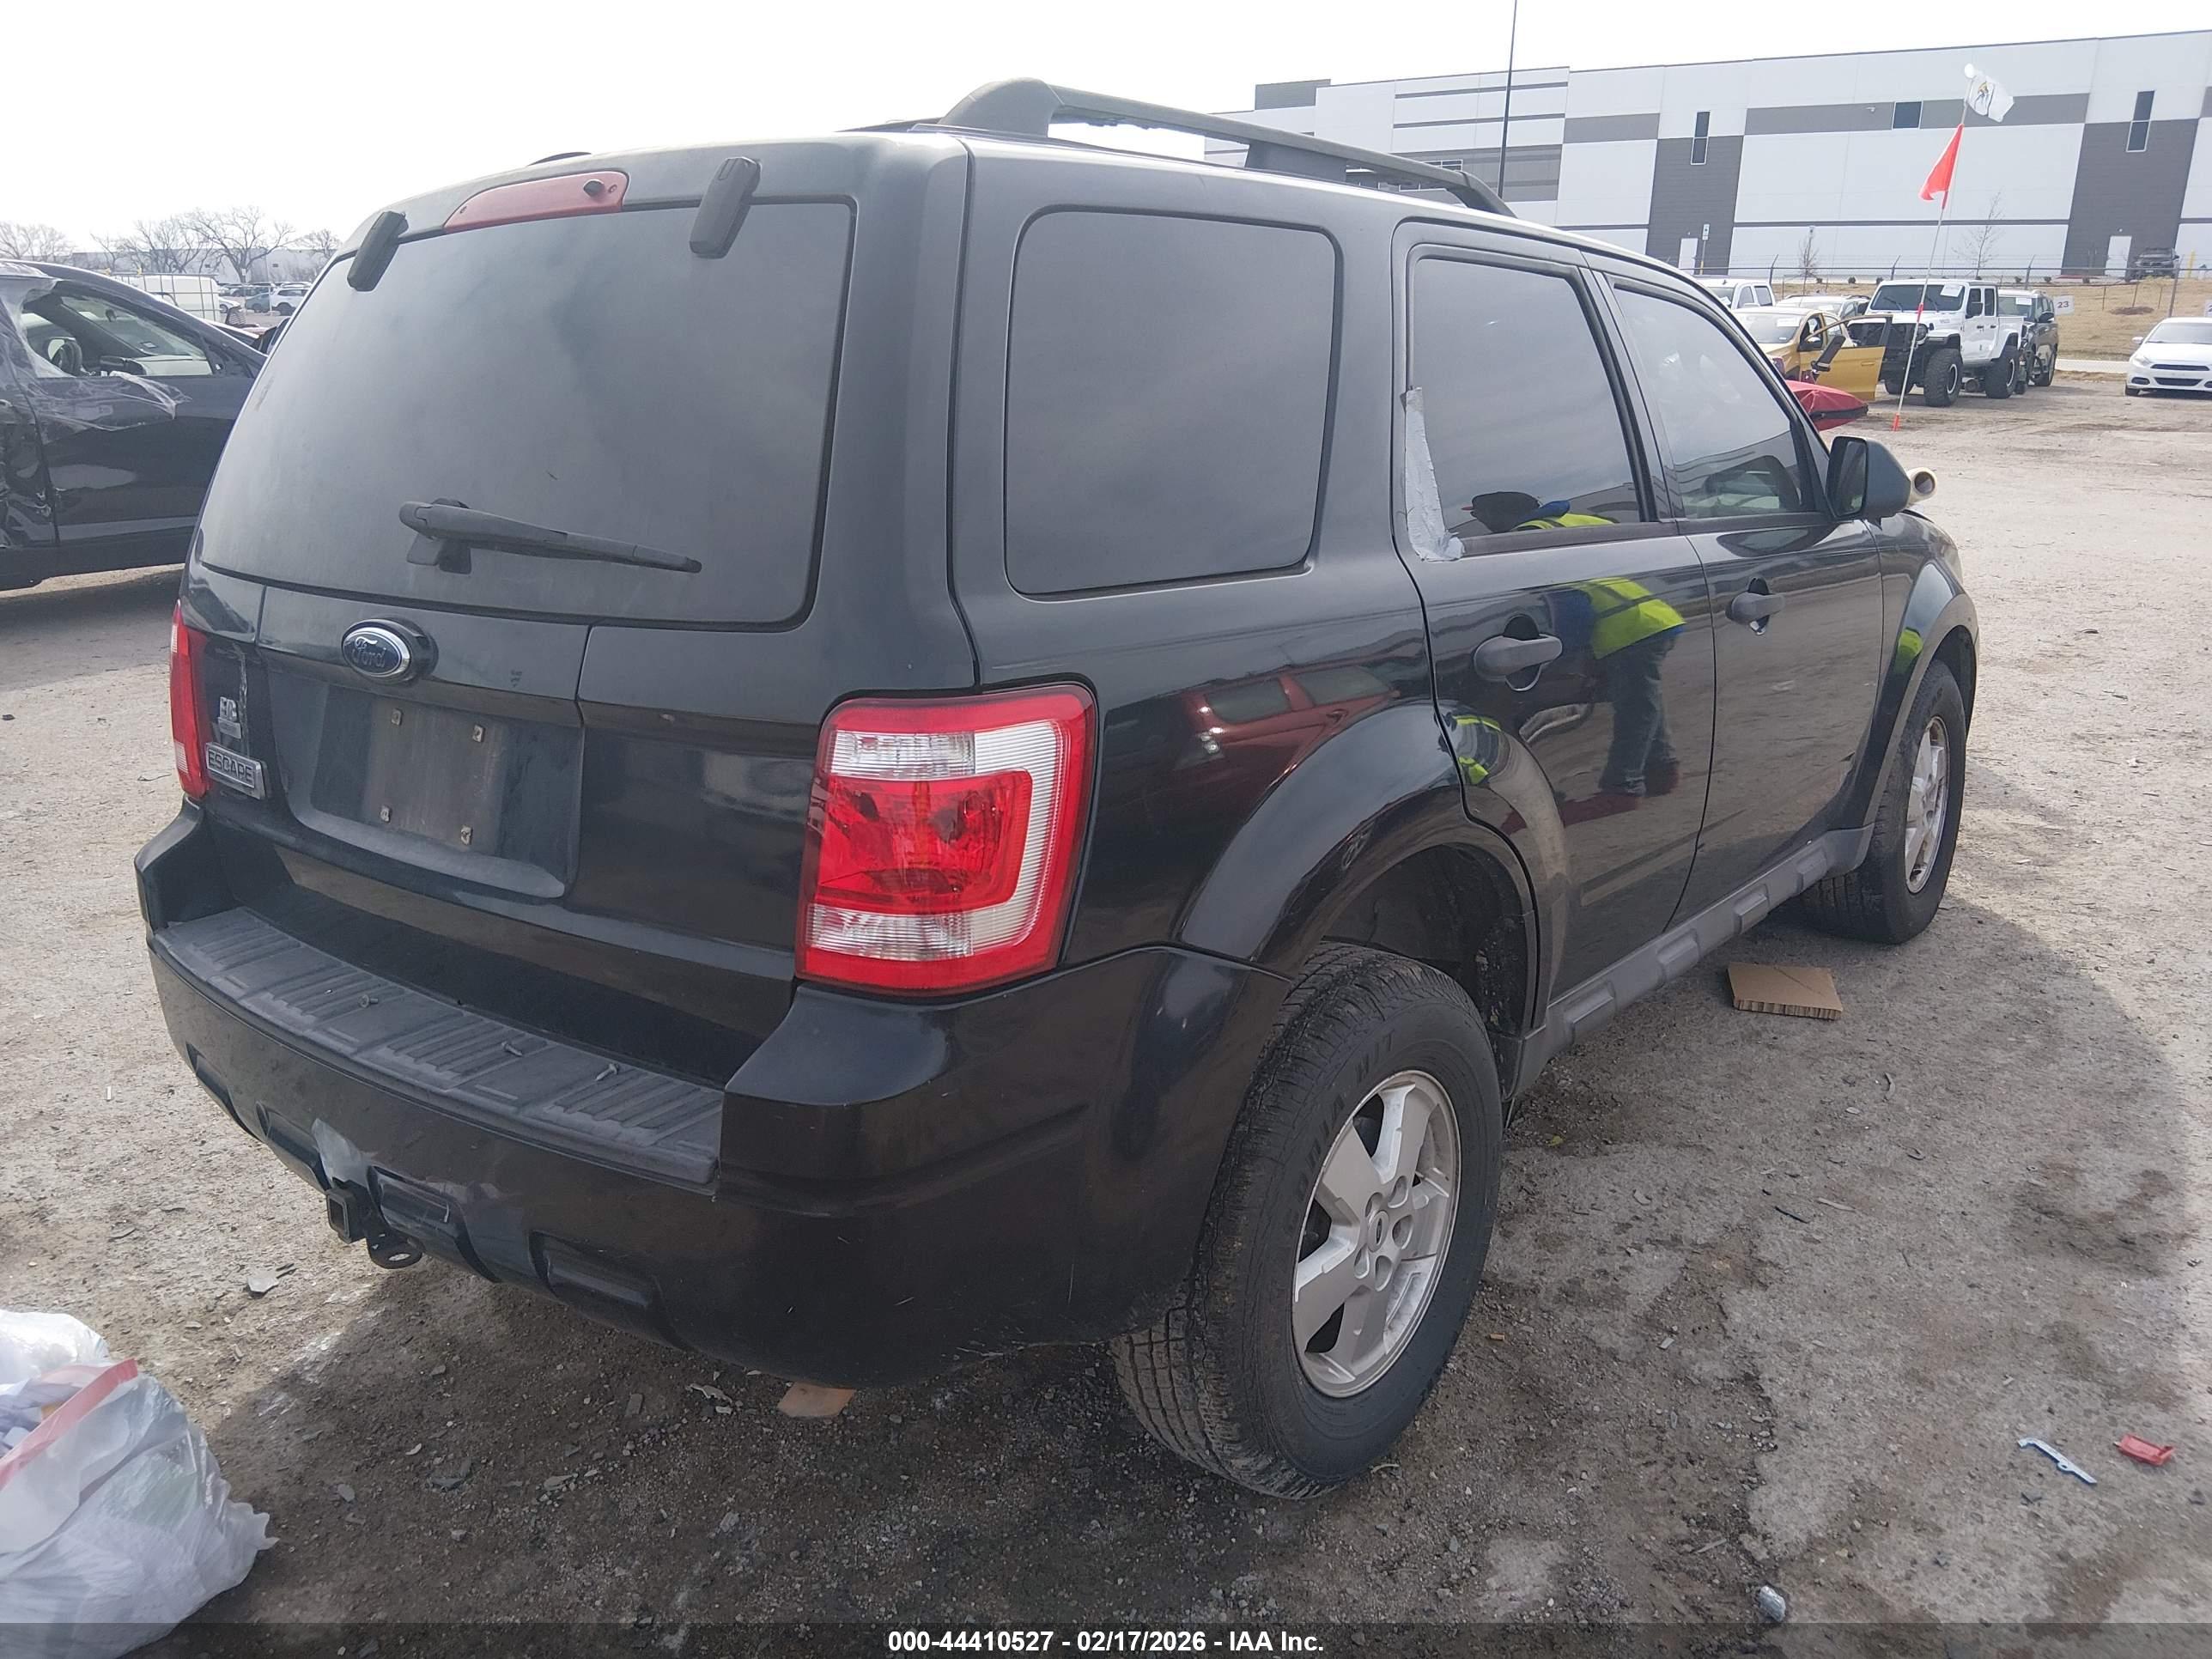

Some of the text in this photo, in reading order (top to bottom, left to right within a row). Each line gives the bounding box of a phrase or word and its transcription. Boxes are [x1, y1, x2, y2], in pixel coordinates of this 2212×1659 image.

[2057, 301, 2069, 309] 23
[350, 635, 387, 668] Ford
[208, 748, 255, 785] ESCAPE
